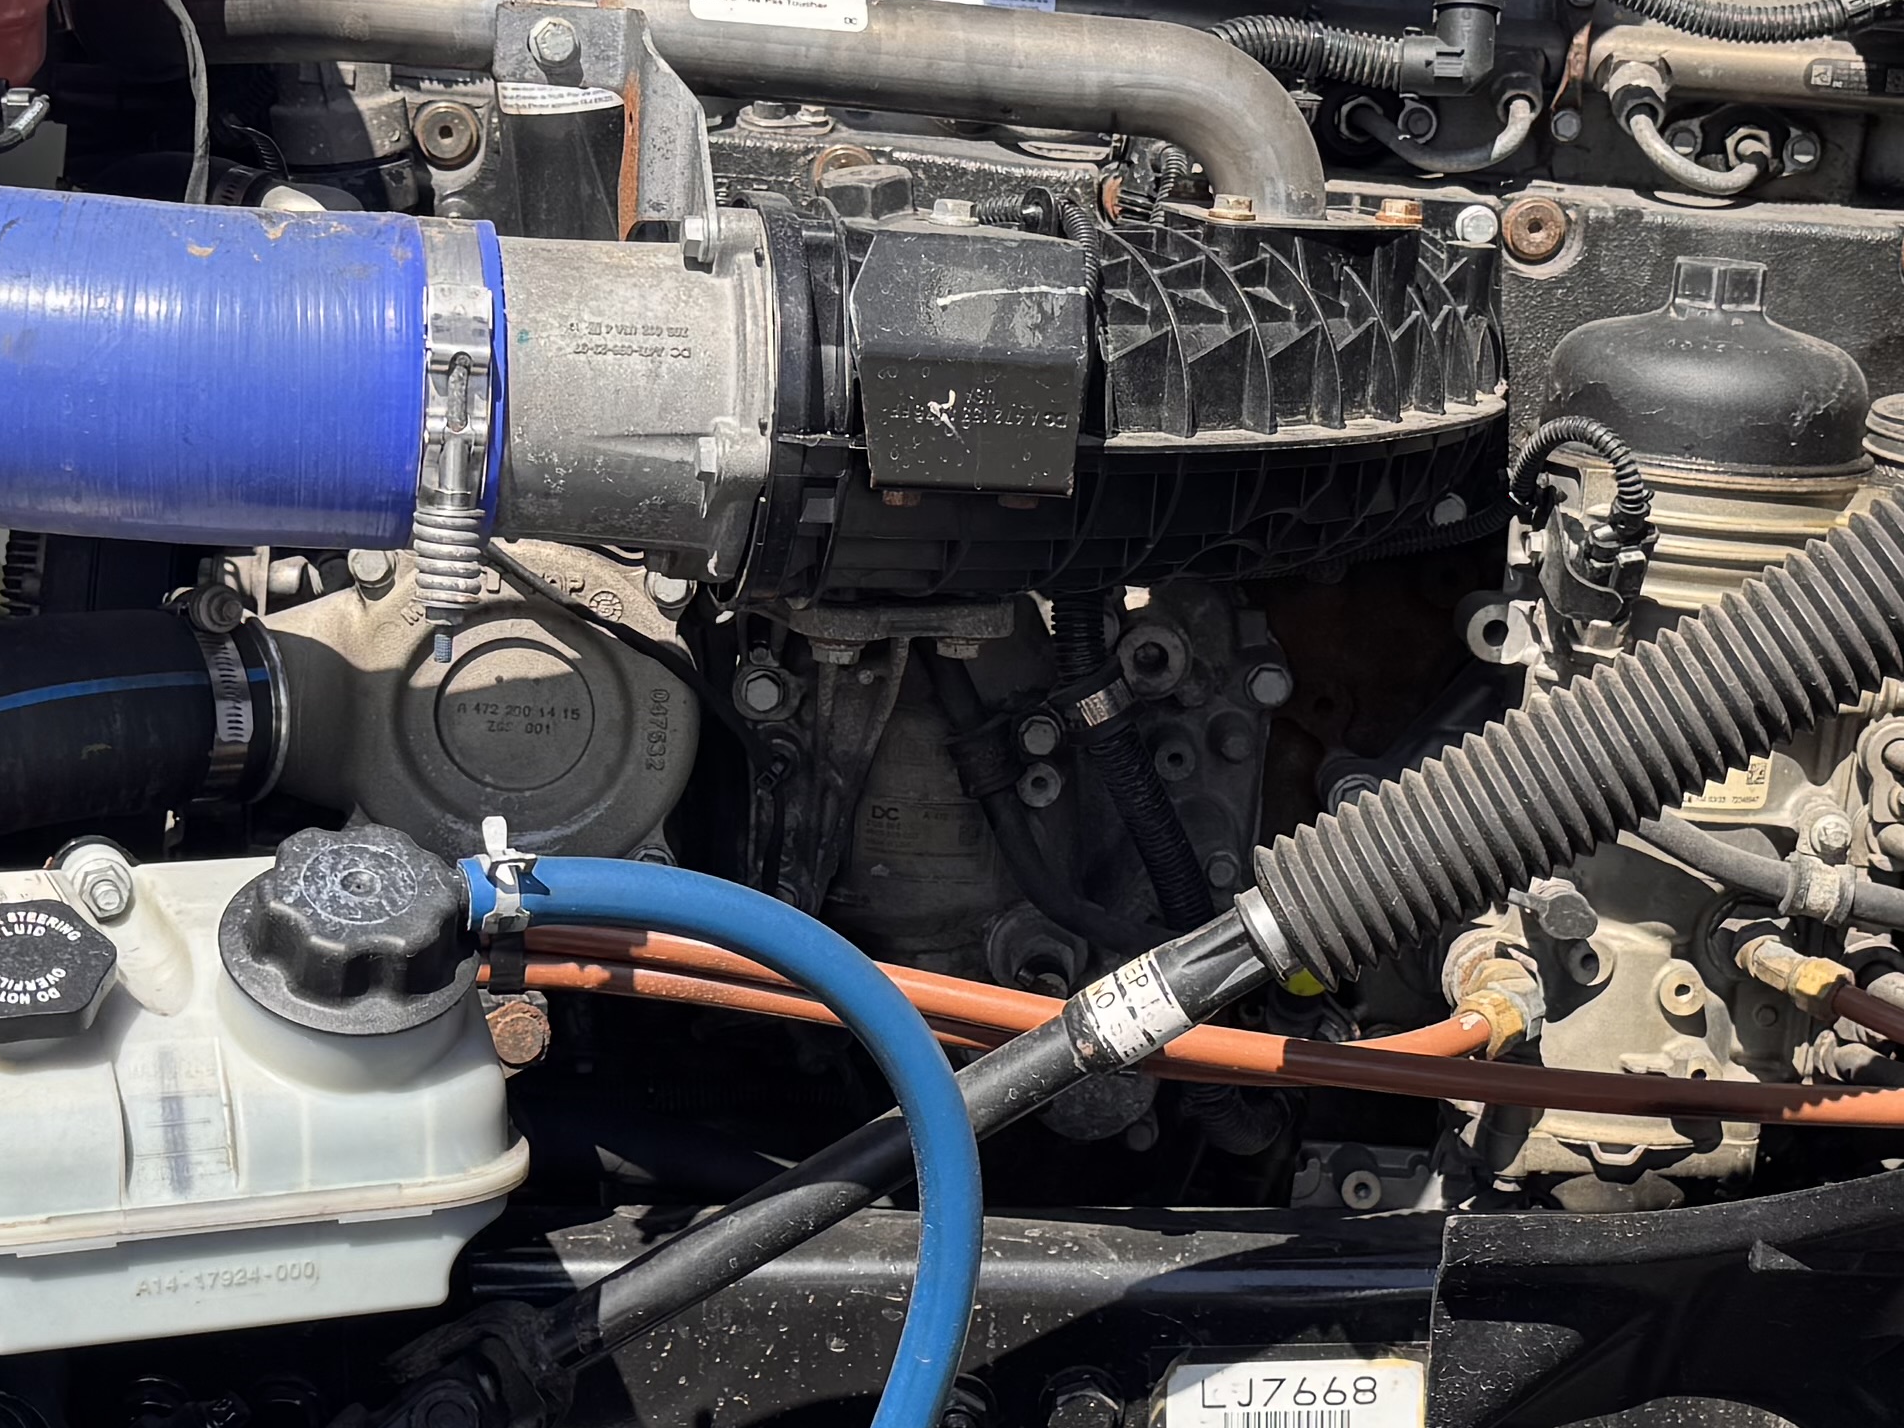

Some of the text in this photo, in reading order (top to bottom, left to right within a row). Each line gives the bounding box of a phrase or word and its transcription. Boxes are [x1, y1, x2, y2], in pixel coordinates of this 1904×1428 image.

[472, 702, 500, 715] 472
[871, 805, 899, 821] DC
[6, 911, 82, 942] STEERING
[36, 989, 62, 1004] DO
[1201, 1376, 1377, 1409] LJ7668
